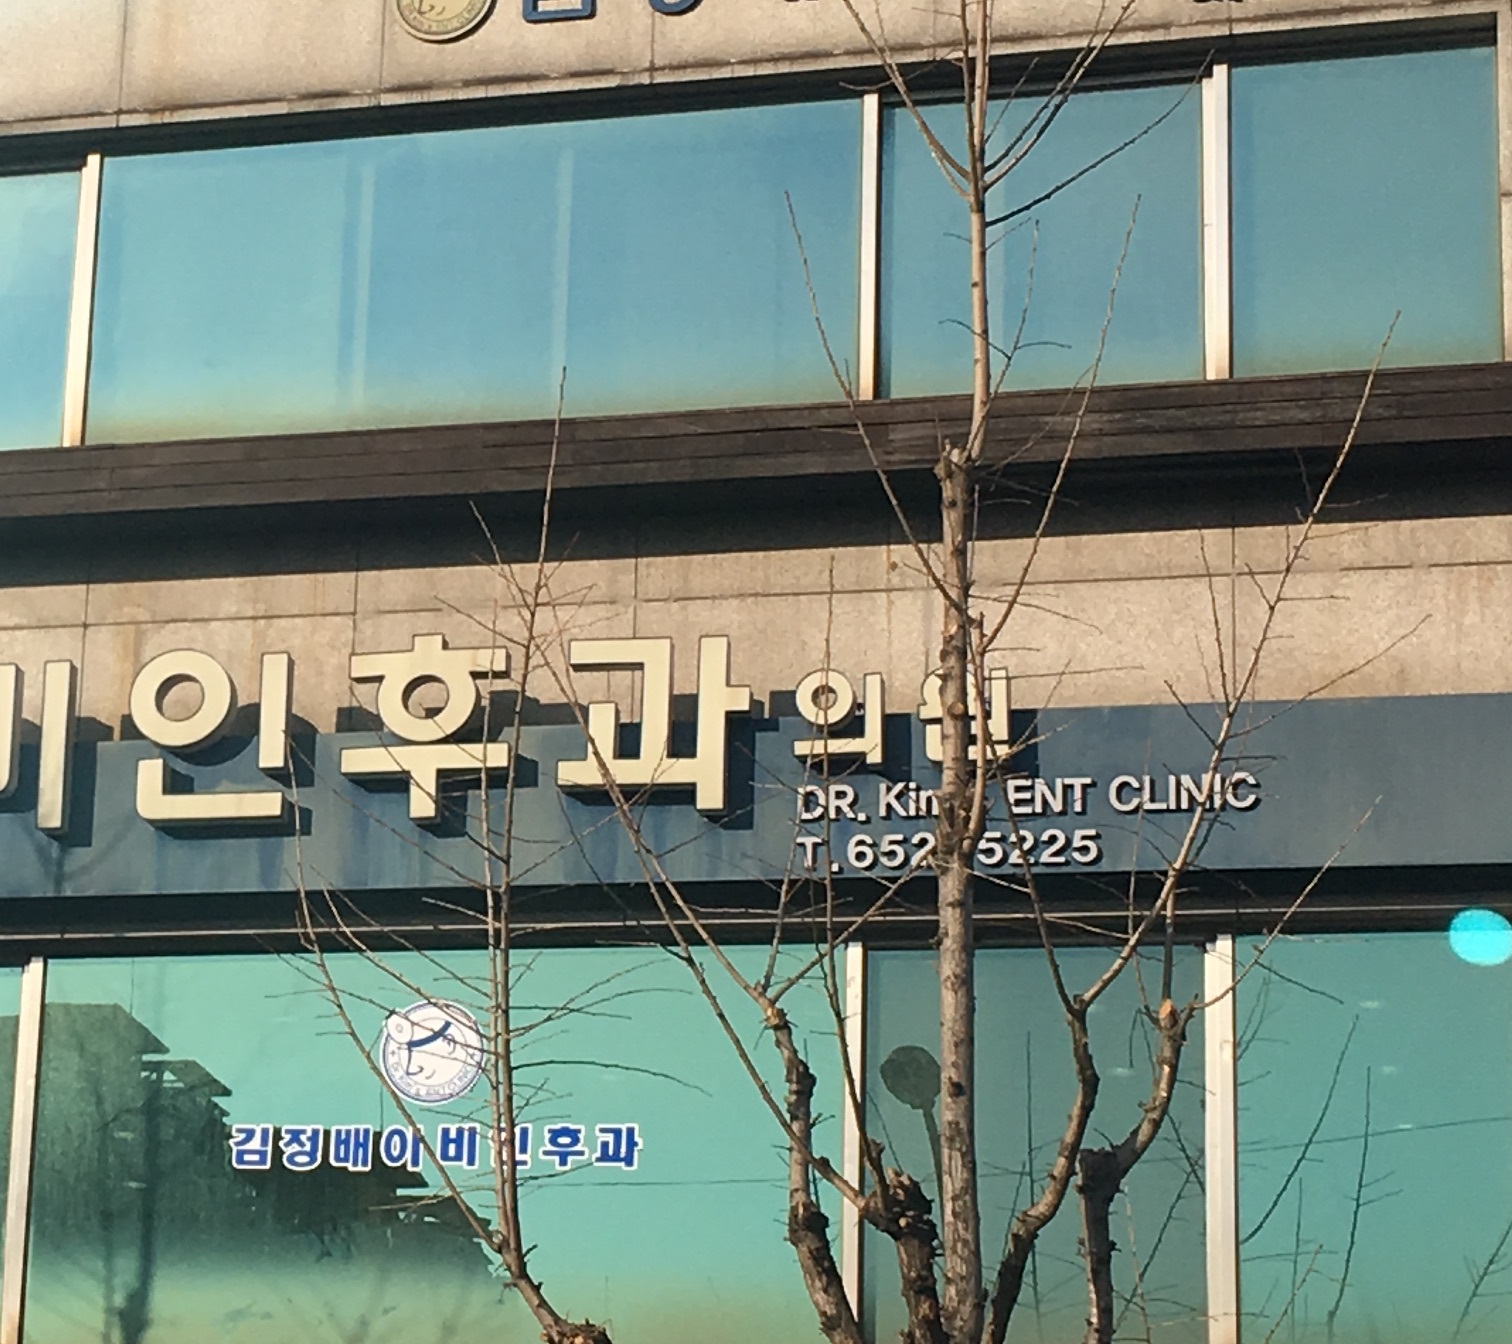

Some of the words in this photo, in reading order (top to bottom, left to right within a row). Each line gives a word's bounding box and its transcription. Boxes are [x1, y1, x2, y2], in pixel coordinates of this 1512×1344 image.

[798, 783, 868, 822] DR.
[1006, 775, 1094, 817] ENT
[1108, 770, 1262, 813] CLINIC
[798, 828, 1103, 873] T.6525225
